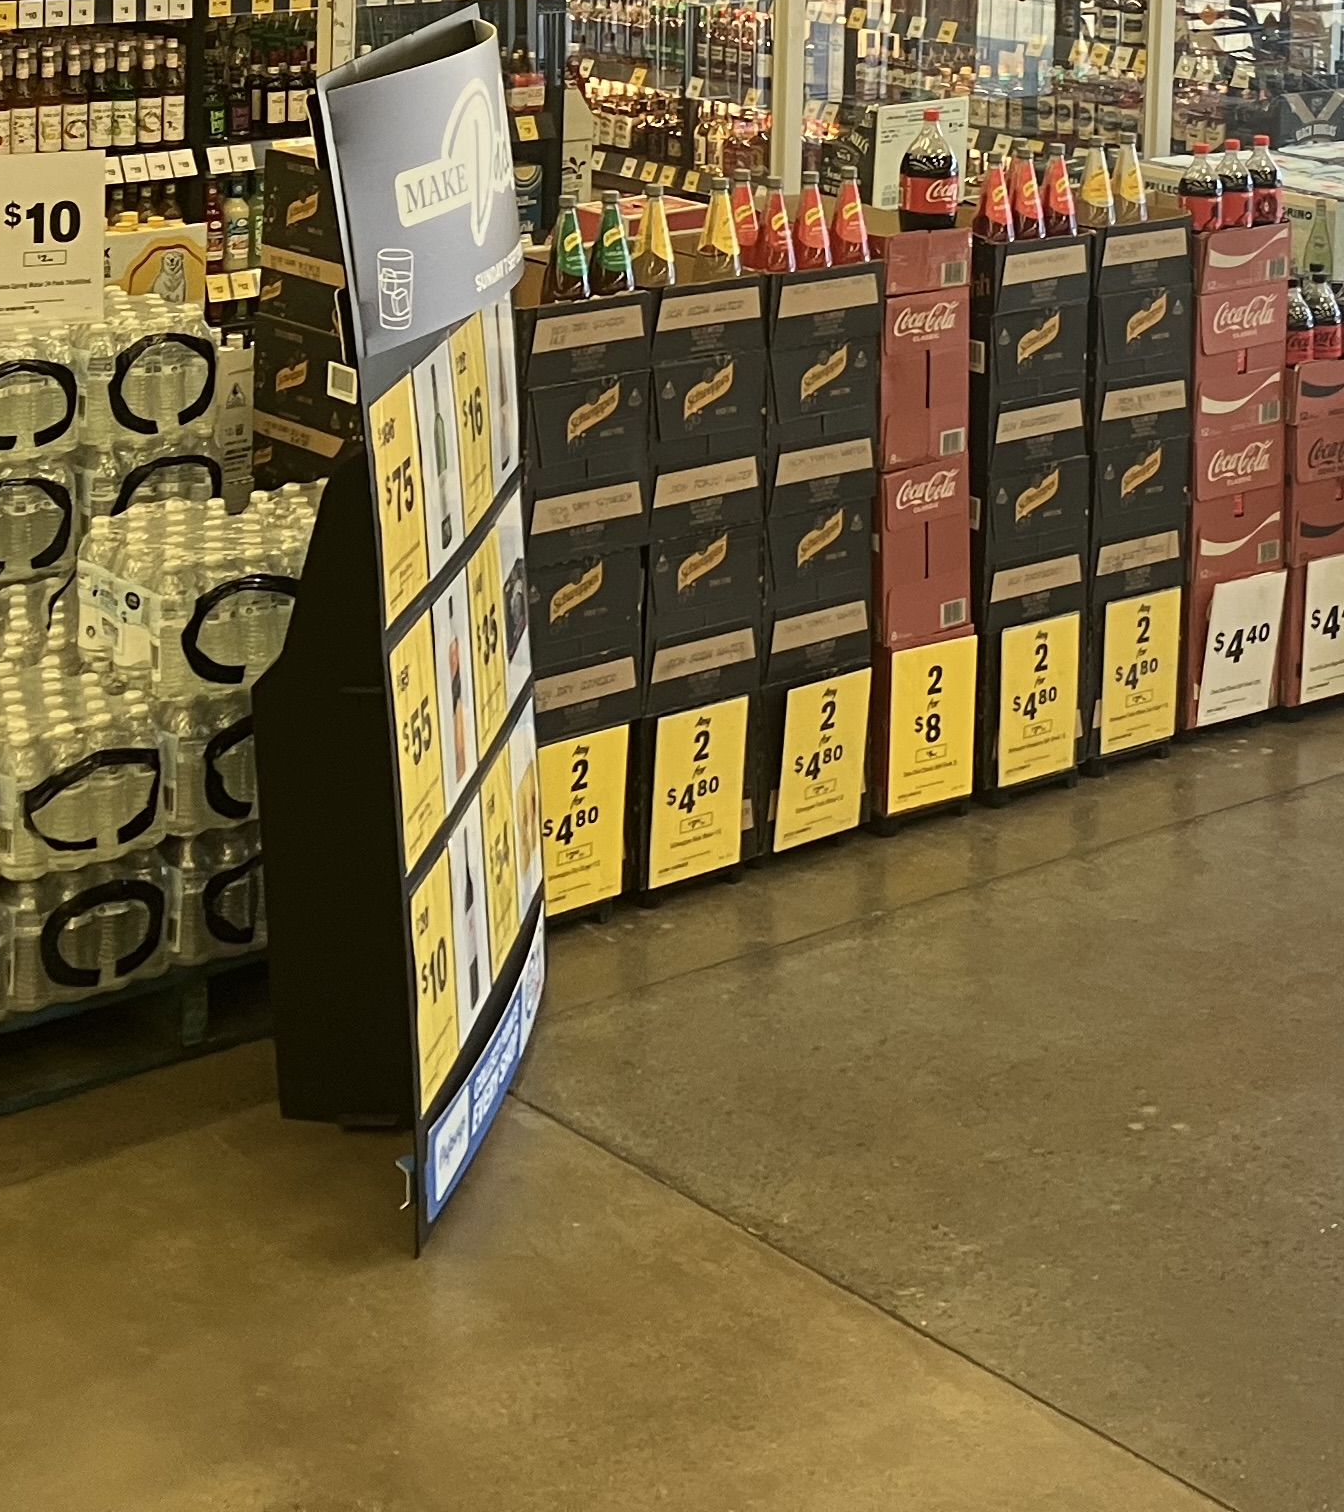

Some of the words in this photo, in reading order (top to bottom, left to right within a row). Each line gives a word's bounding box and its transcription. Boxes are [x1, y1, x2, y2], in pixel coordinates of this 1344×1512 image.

[404, 163, 469, 214] MAKE
[4, 200, 81, 244] $10
[463, 386, 484, 442] $16
[385, 456, 414, 523] $75
[476, 603, 498, 666] $35
[1136, 616, 1151, 644] 2
[1034, 643, 1049, 673] 2
[927, 664, 943, 696] 2
[403, 695, 433, 767] $55
[819, 701, 837, 731] 2
[914, 713, 942, 743] $8
[693, 730, 710, 763] 2
[570, 759, 589, 792] 2
[421, 936, 447, 1005] $10
